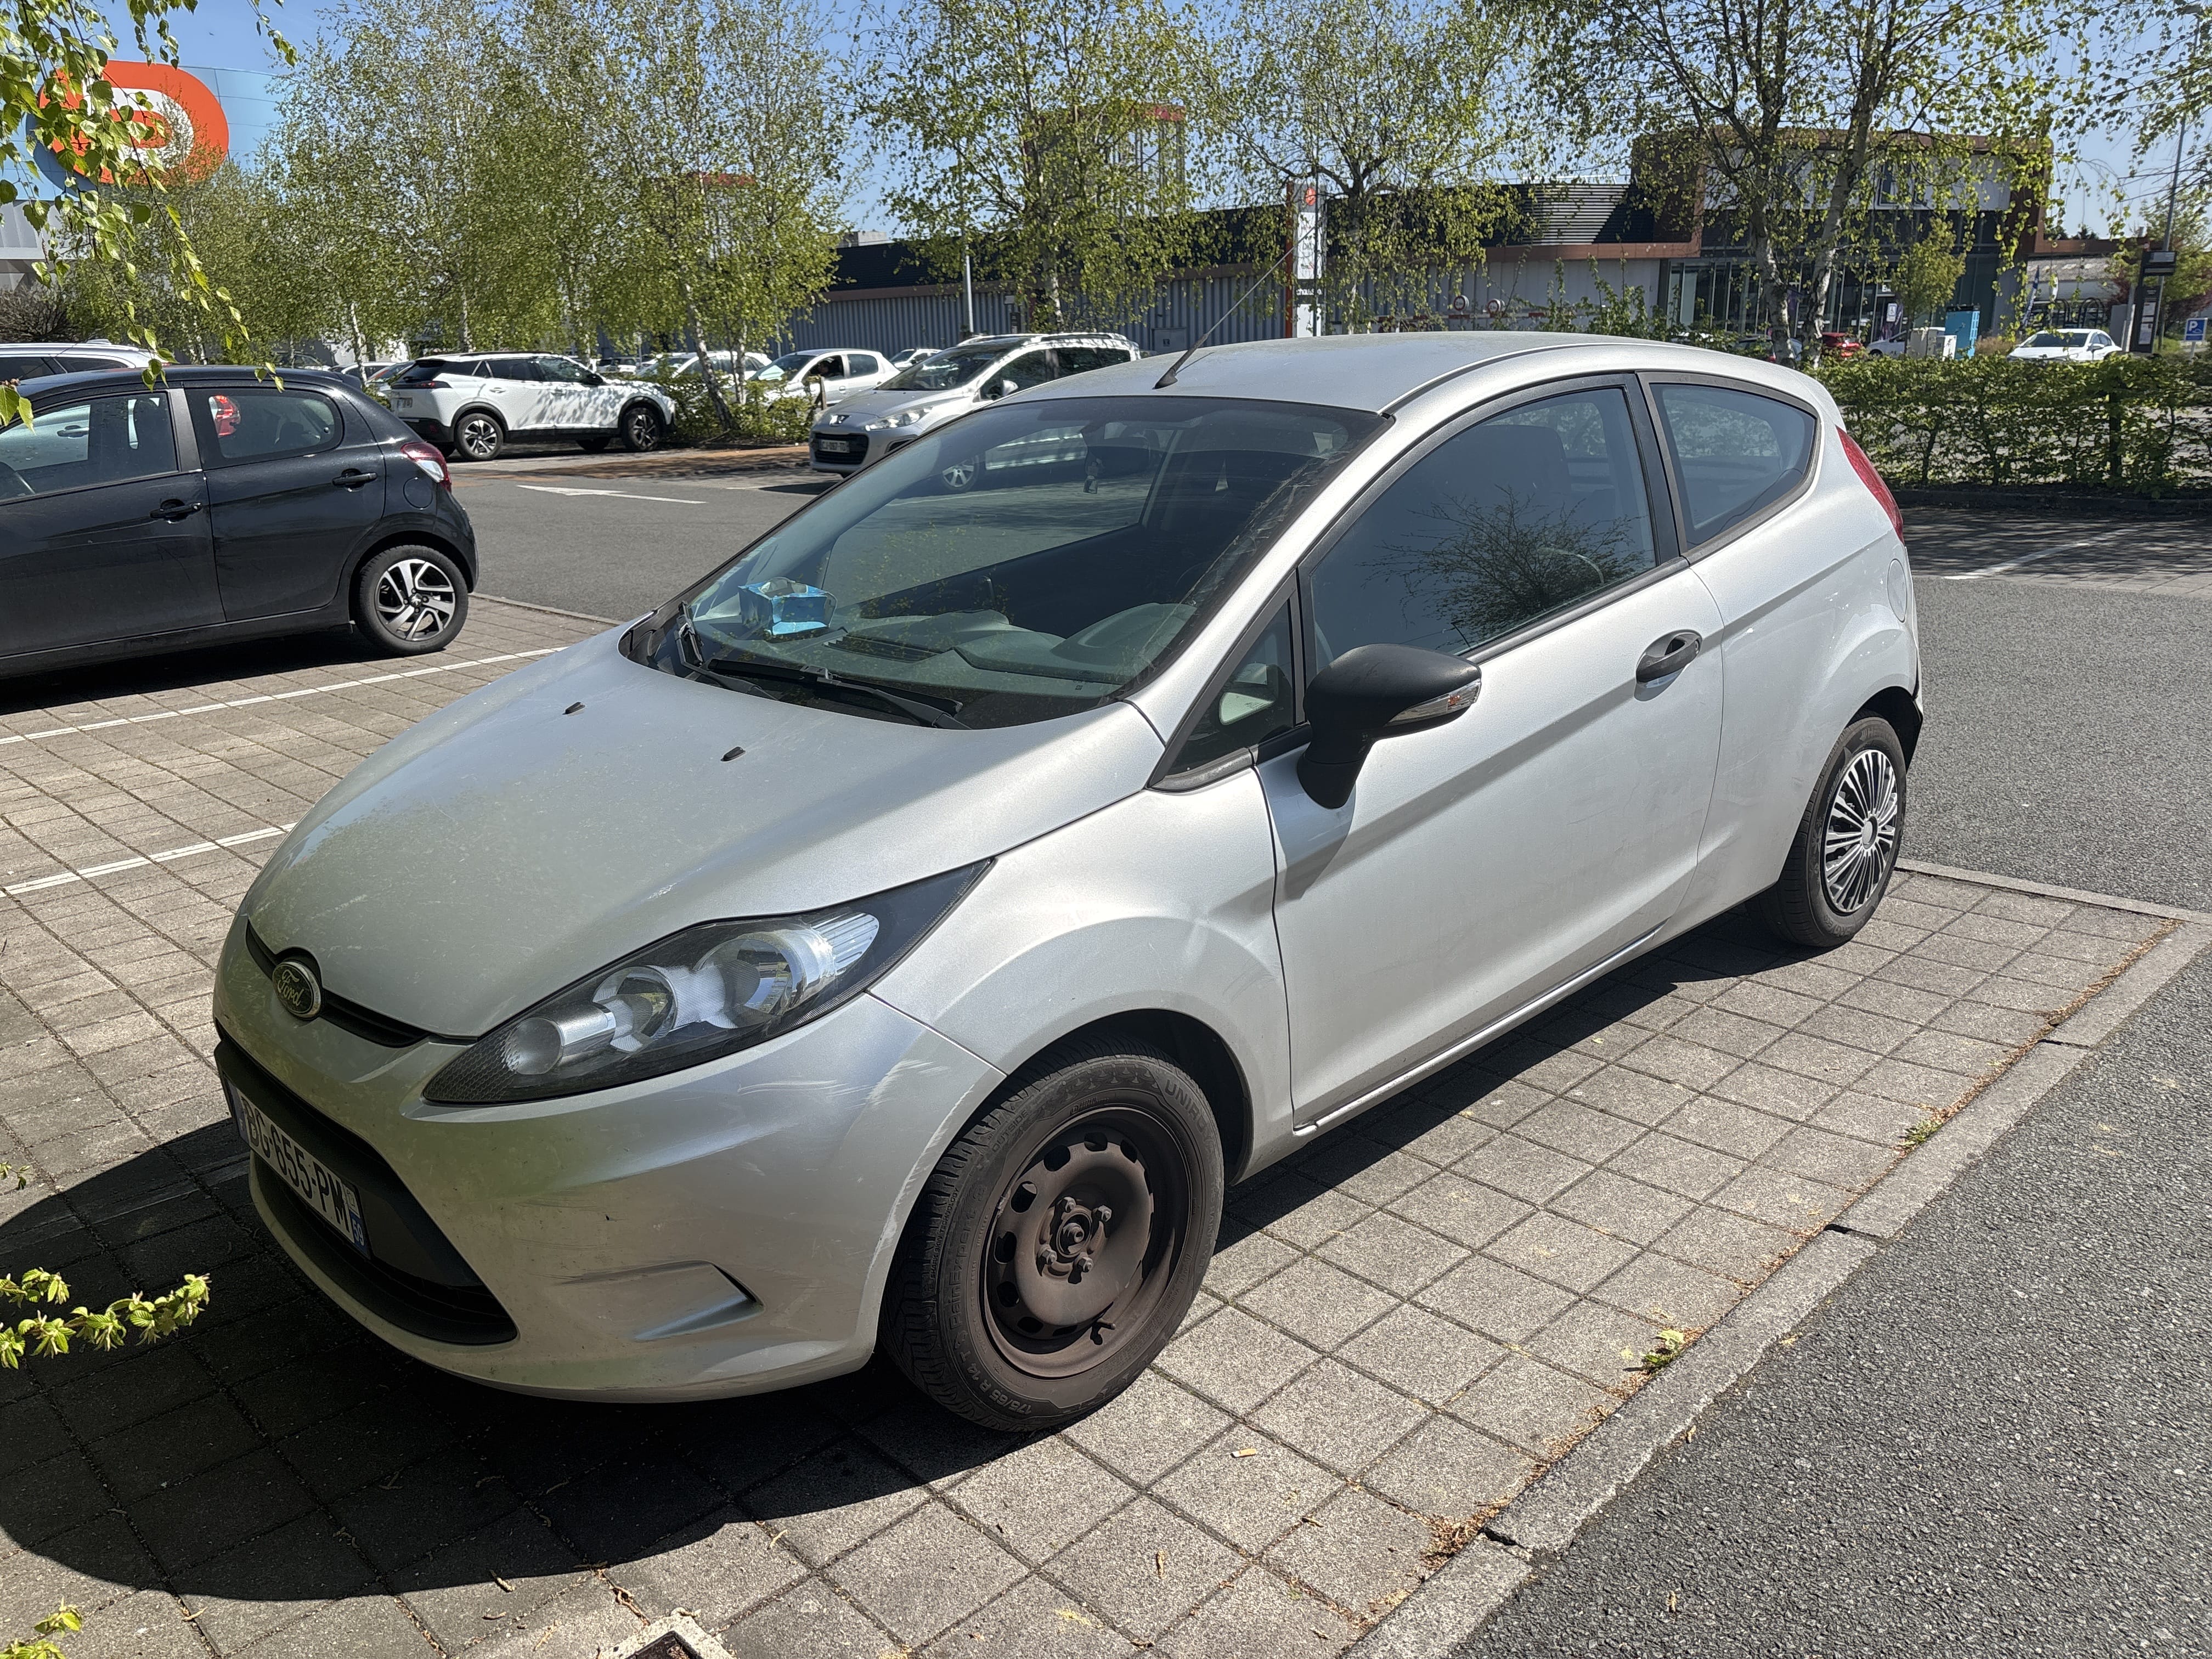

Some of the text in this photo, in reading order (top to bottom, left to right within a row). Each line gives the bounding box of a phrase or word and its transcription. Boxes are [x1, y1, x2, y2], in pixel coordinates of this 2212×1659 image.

[2189, 321, 2198, 331] P
[278, 969, 304, 1006] Ford
[992, 1109, 1029, 1154] OUTSIDE
[1164, 1081, 1221, 1174] UNIROYAL
[241, 1096, 351, 1234] BG-655-PM
[352, 1218, 365, 1246] 59
[935, 1234, 944, 1252] SKIN
[948, 1209, 978, 1329] RainExpert
[967, 1362, 980, 1381] 14
[980, 1379, 992, 1392] R
[990, 1389, 1032, 1415] 175/65
